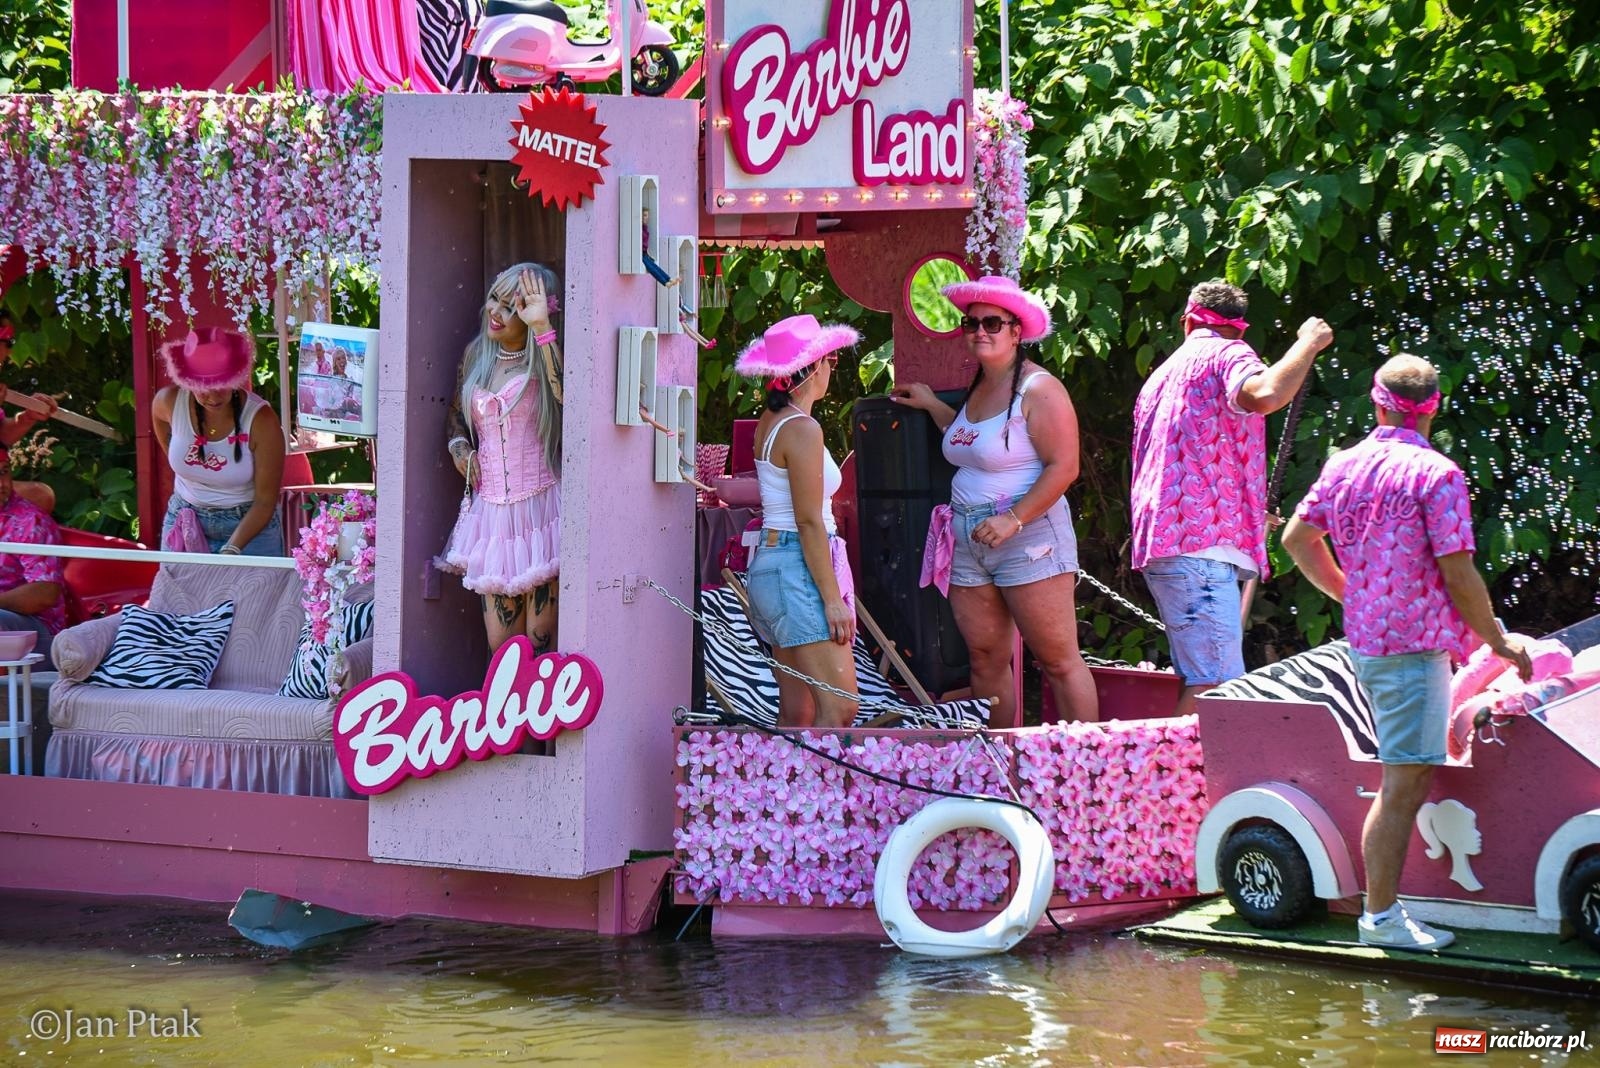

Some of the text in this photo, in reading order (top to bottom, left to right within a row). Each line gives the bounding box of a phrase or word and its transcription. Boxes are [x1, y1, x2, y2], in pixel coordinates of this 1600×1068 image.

[733, 0, 908, 166] Barbie
[517, 124, 602, 169] MATTEL
[862, 103, 965, 178] Land
[184, 444, 222, 471] Babie
[338, 642, 590, 786] Barbie
